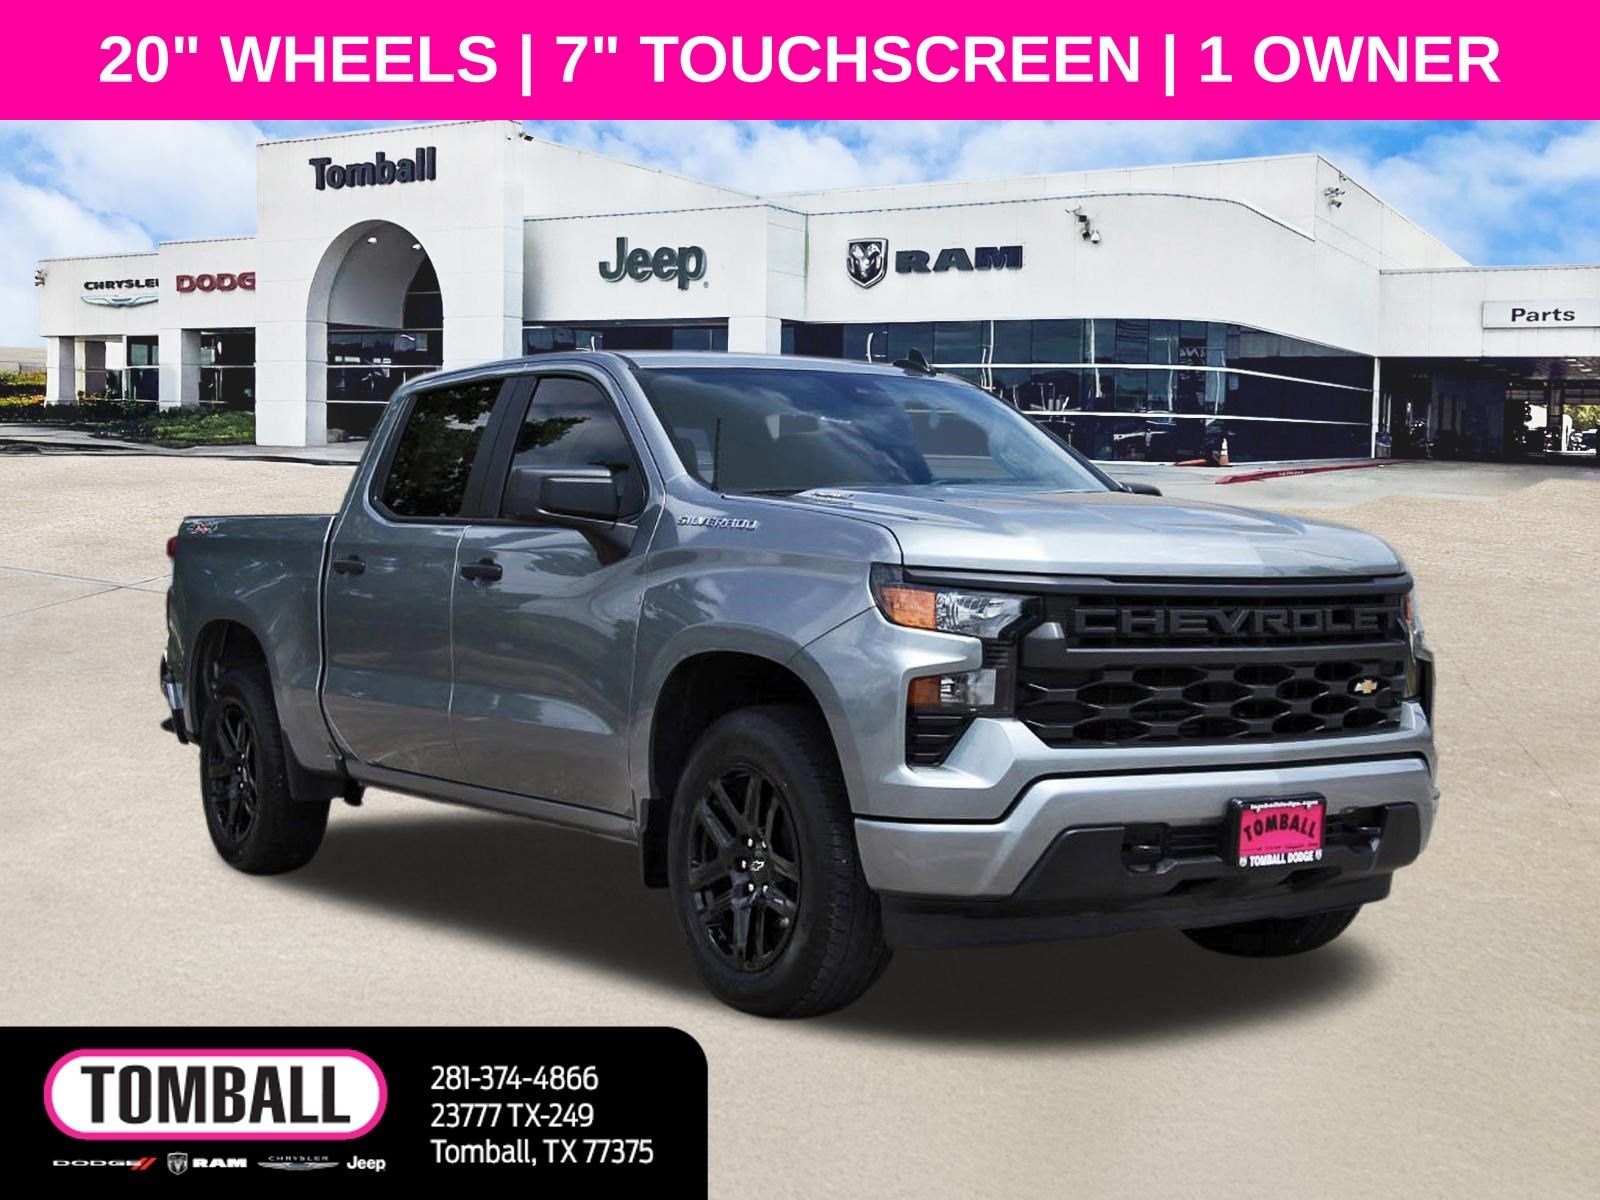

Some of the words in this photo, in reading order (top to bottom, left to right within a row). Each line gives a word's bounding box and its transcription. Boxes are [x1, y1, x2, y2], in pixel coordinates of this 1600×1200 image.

[307, 145, 437, 191] Tomball
[598, 236, 706, 290] Jeep
[895, 245, 1023, 274] RAM
[1510, 307, 1576, 323] Parts
[1243, 813, 1317, 841] TOMBALL
[1249, 852, 1286, 867] TOMBALL
[1287, 850, 1314, 864] DODGE
